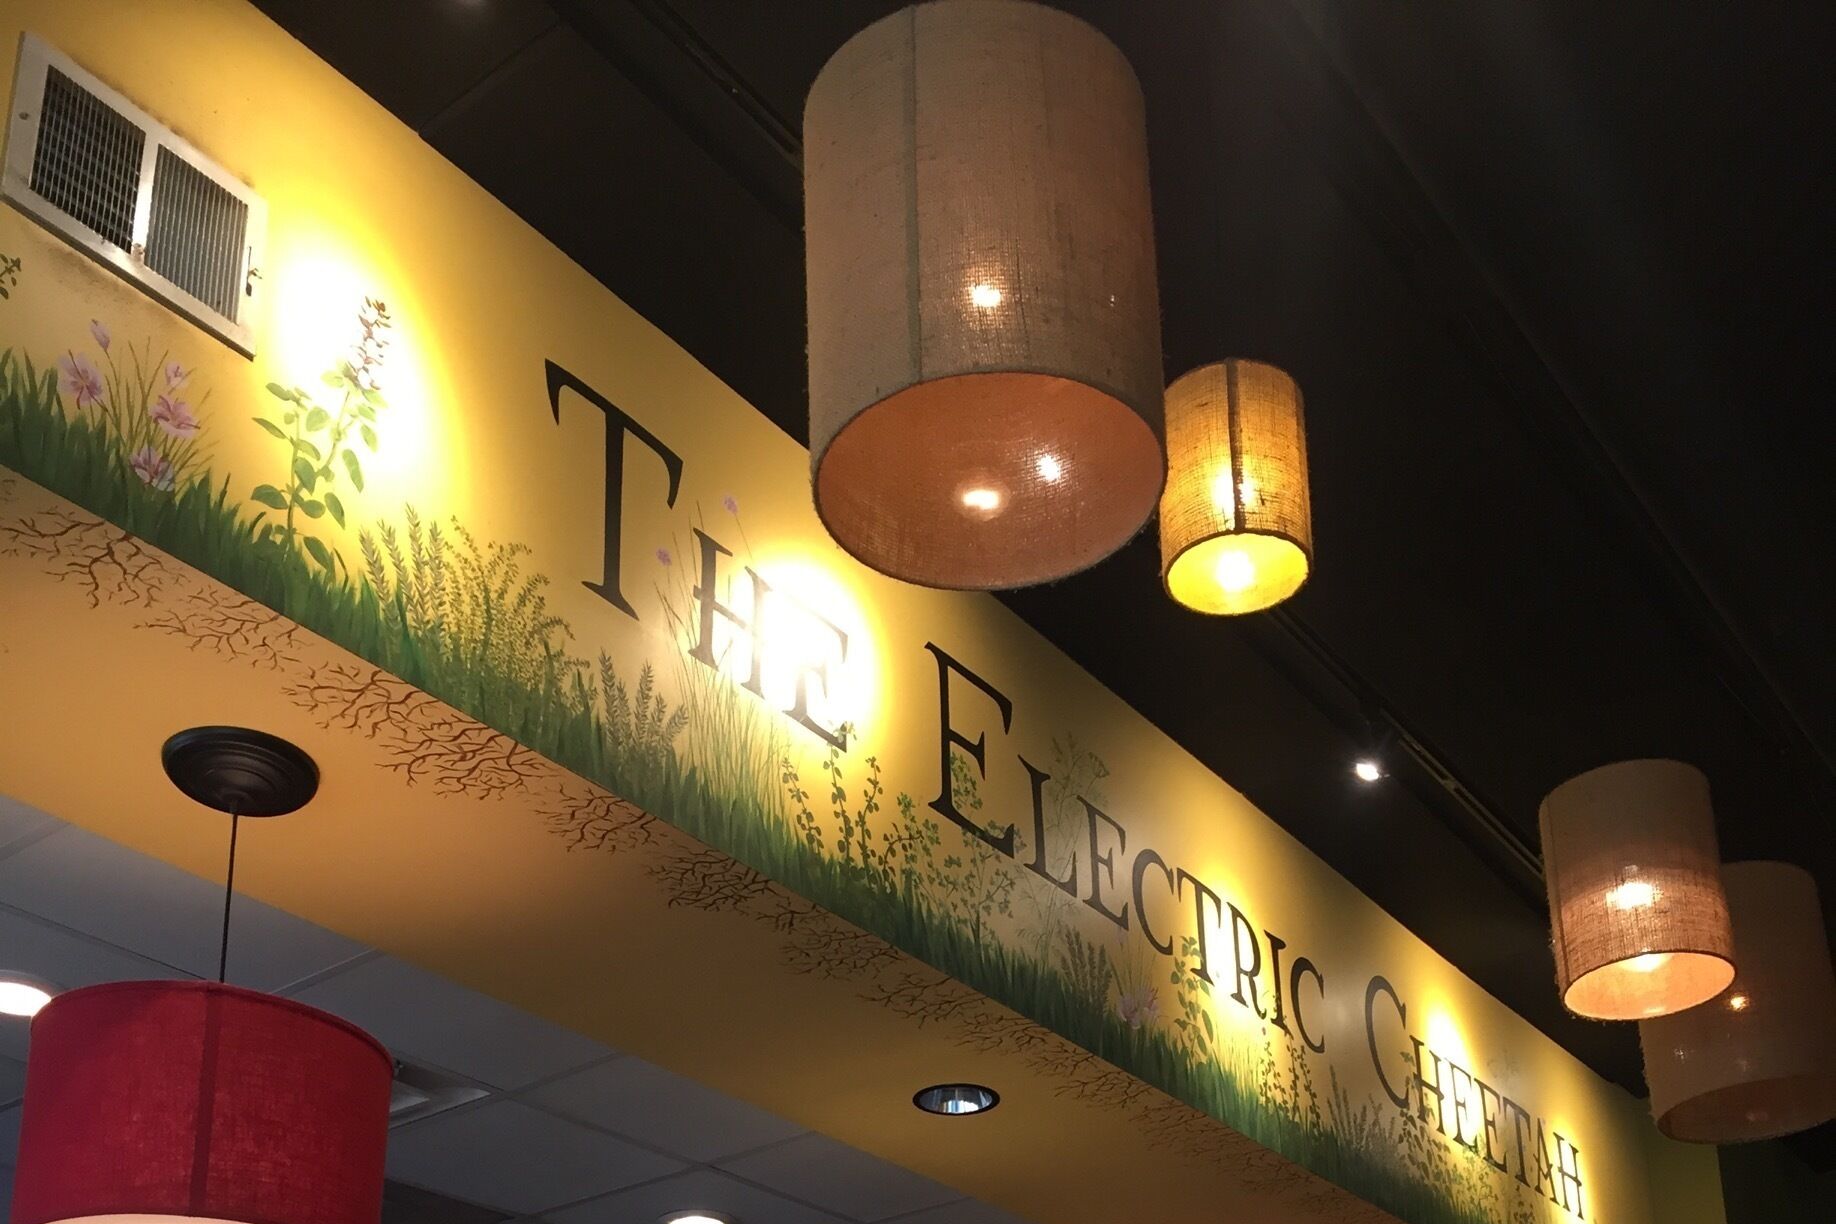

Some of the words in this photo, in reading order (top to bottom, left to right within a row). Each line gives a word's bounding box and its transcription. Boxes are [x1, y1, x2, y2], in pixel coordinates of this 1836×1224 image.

[544, 358, 849, 753] THE
[924, 641, 1325, 1054] ELECTRIC
[1364, 975, 1585, 1221] CHEETAH
